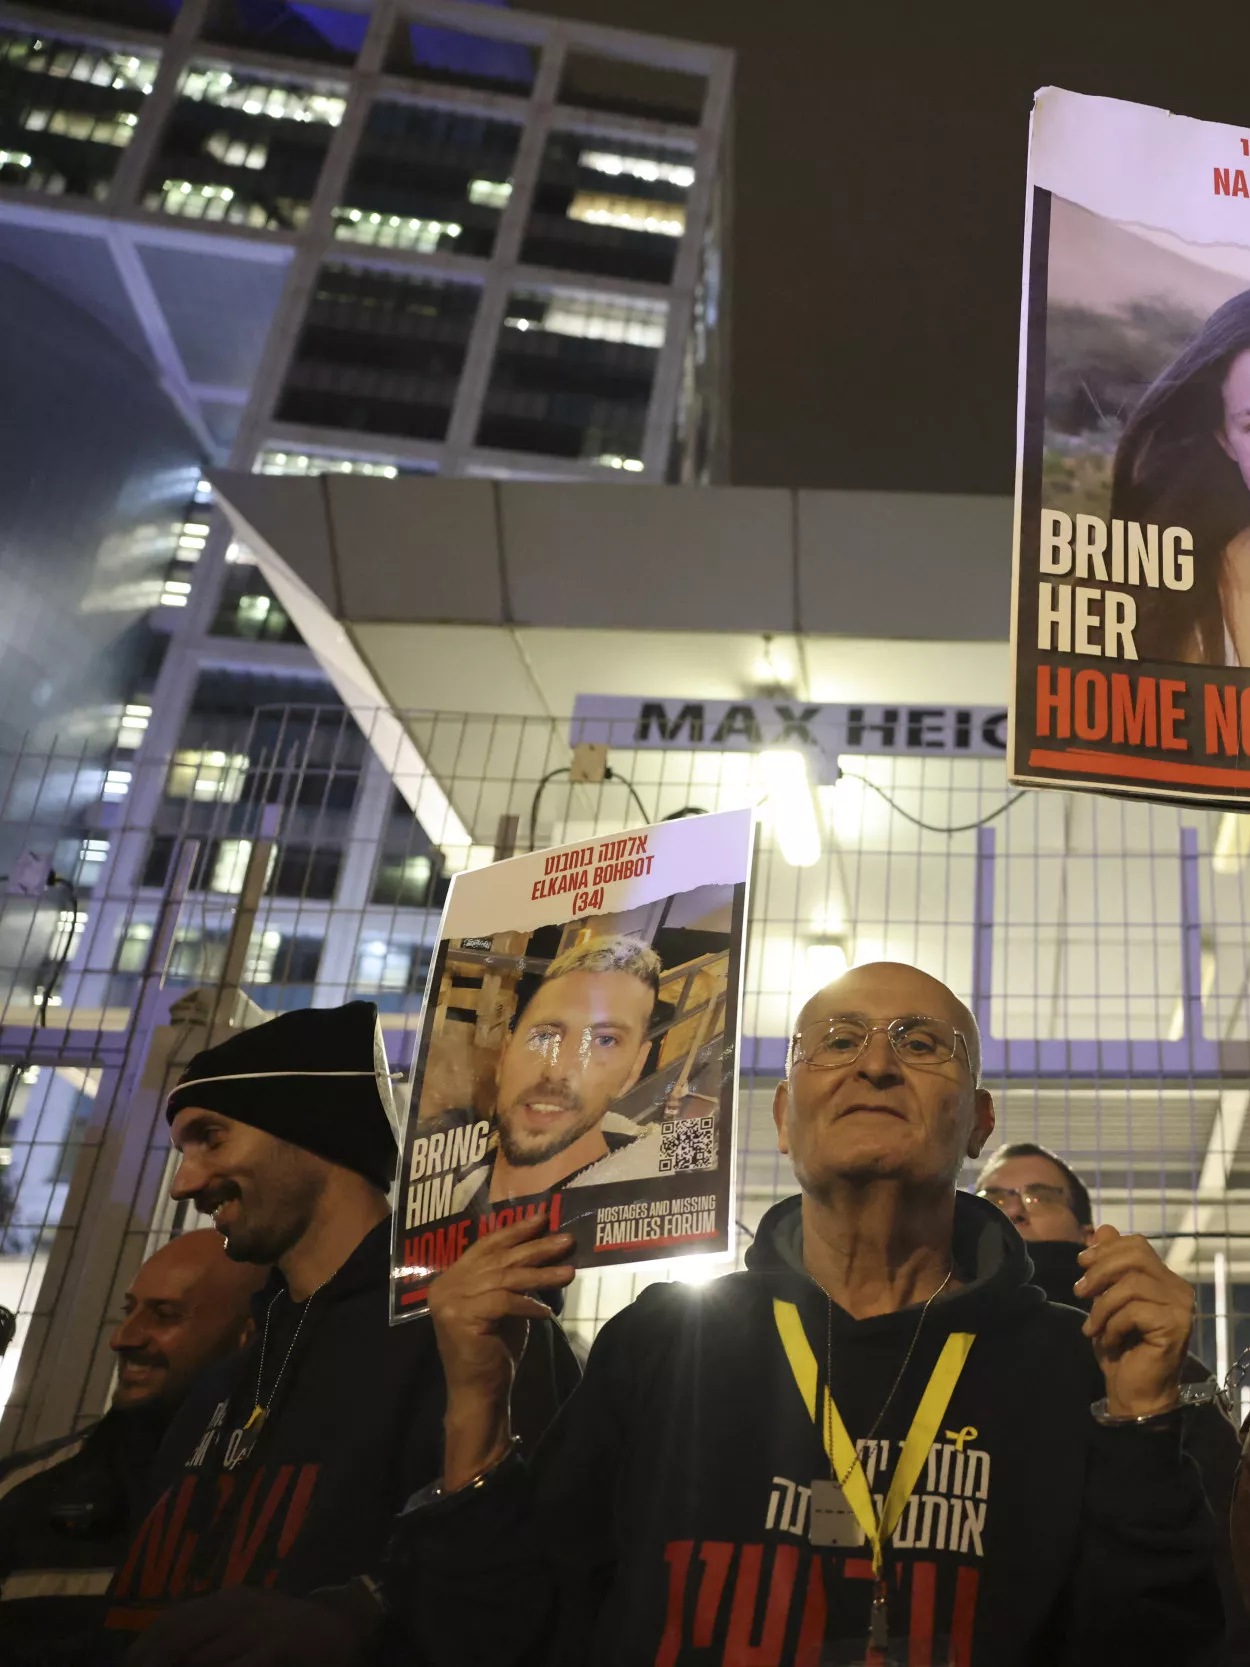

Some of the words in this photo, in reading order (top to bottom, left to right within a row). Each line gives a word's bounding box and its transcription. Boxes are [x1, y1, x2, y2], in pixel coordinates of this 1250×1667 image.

[1039, 508, 1195, 591] BRING
[1037, 582, 1139, 661] HER
[638, 702, 823, 744] MAX
[1036, 665, 1188, 751] HOME
[544, 847, 594, 876] בוחבוט
[598, 835, 648, 863] אלקנה
[531, 869, 588, 901] ELKANA
[592, 855, 655, 887] BOHBOT
[572, 887, 605, 915] (34)
[410, 1120, 490, 1182] BRING
[405, 1173, 454, 1230] HIM
[597, 1203, 648, 1223] HOSTAGES
[649, 1200, 670, 1216] AND
[671, 1195, 716, 1214] MISSING
[596, 1216, 660, 1246] FAMILIES
[664, 1210, 716, 1238] FORUM
